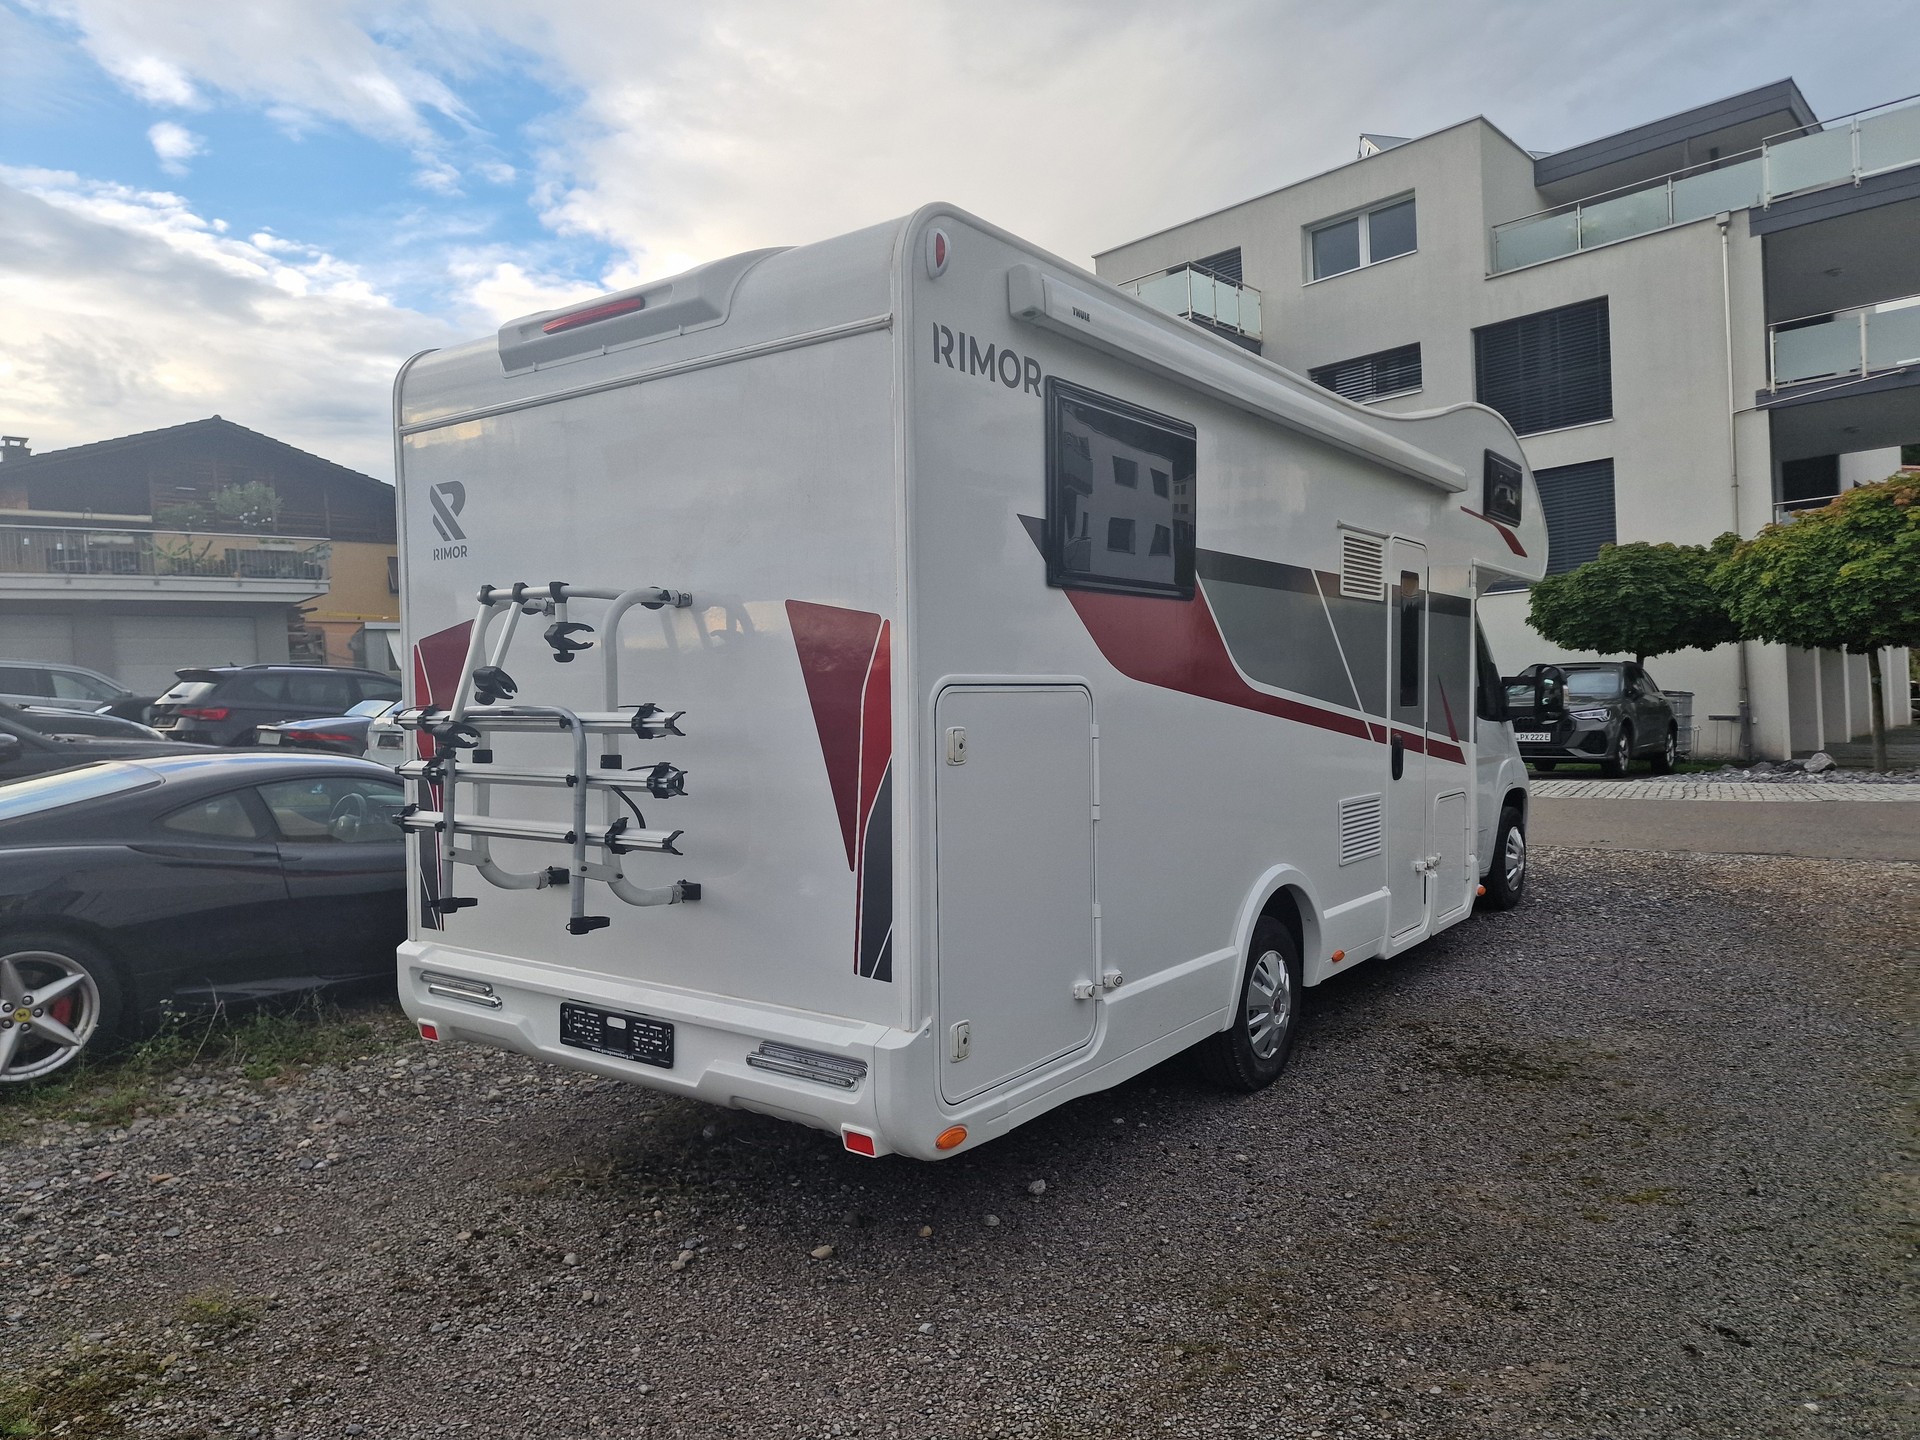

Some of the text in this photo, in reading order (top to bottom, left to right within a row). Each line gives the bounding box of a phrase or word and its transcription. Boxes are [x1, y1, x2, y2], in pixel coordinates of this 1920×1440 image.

[1072, 306, 1091, 322] THULE
[932, 321, 1042, 398] RIMOR
[433, 545, 468, 561] RIMOR
